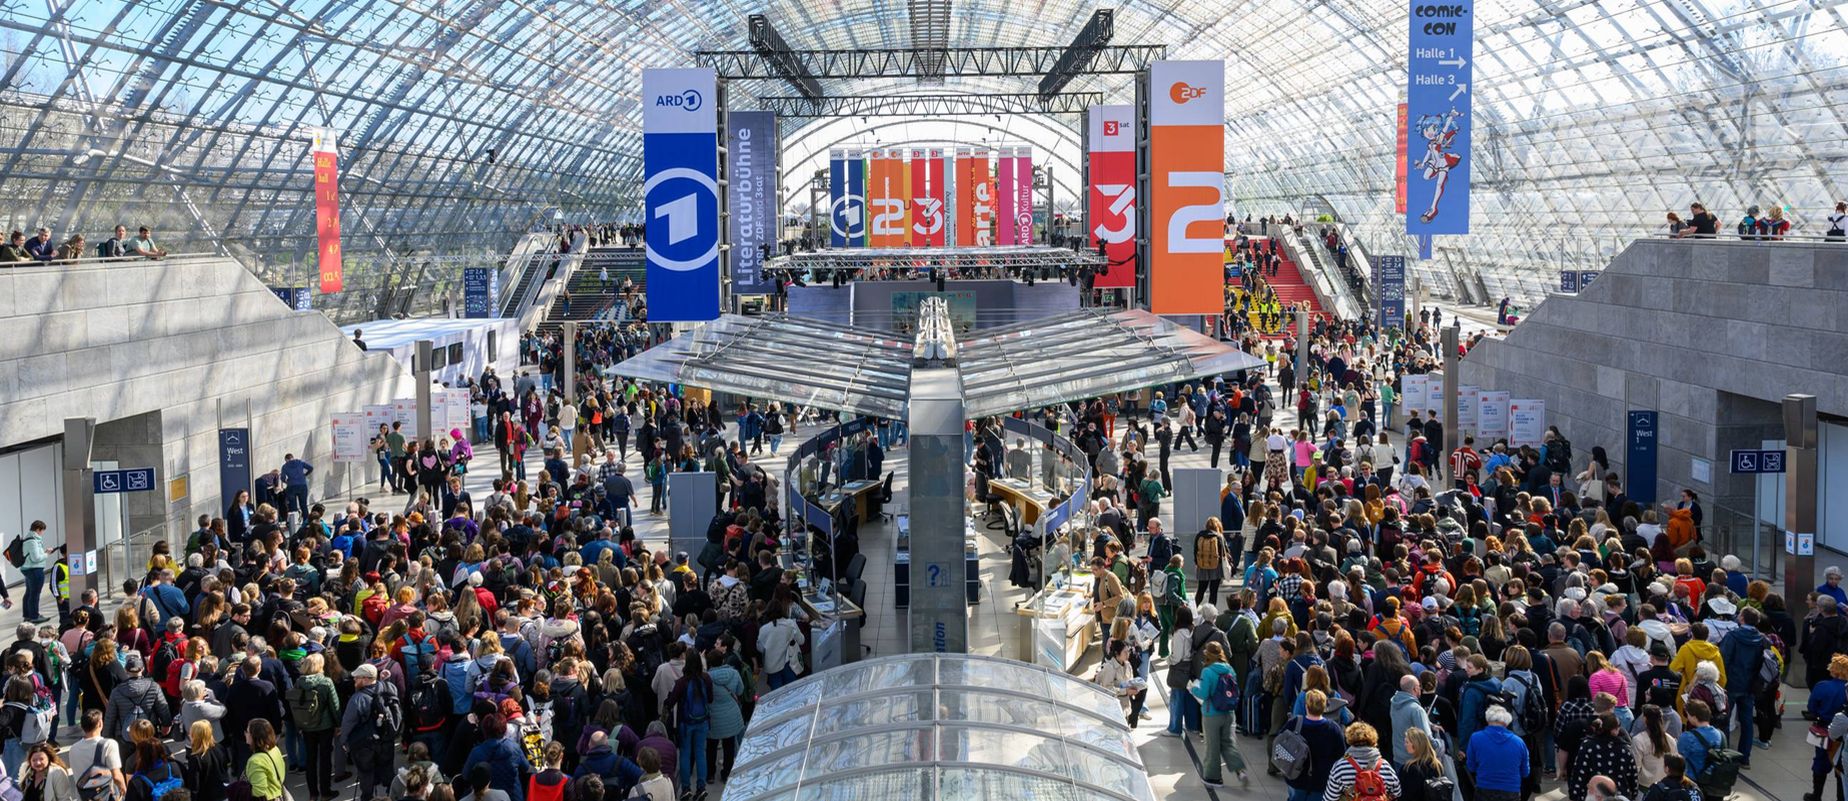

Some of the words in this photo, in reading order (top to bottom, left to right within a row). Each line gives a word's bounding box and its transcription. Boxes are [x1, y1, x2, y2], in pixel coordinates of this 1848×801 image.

[1423, 22, 1456, 35] CON
[1416, 48, 1445, 58] Halle
[1449, 48, 1455, 58] 1
[1416, 75, 1445, 85] Halle
[1448, 74, 1455, 85] 3
[656, 96, 684, 106] ARD
[755, 175, 763, 199] 3sat
[1021, 184, 1029, 213] Kultur
[735, 128, 754, 286] Literaturbühne
[974, 182, 991, 247] arte
[1094, 184, 1135, 244] 3
